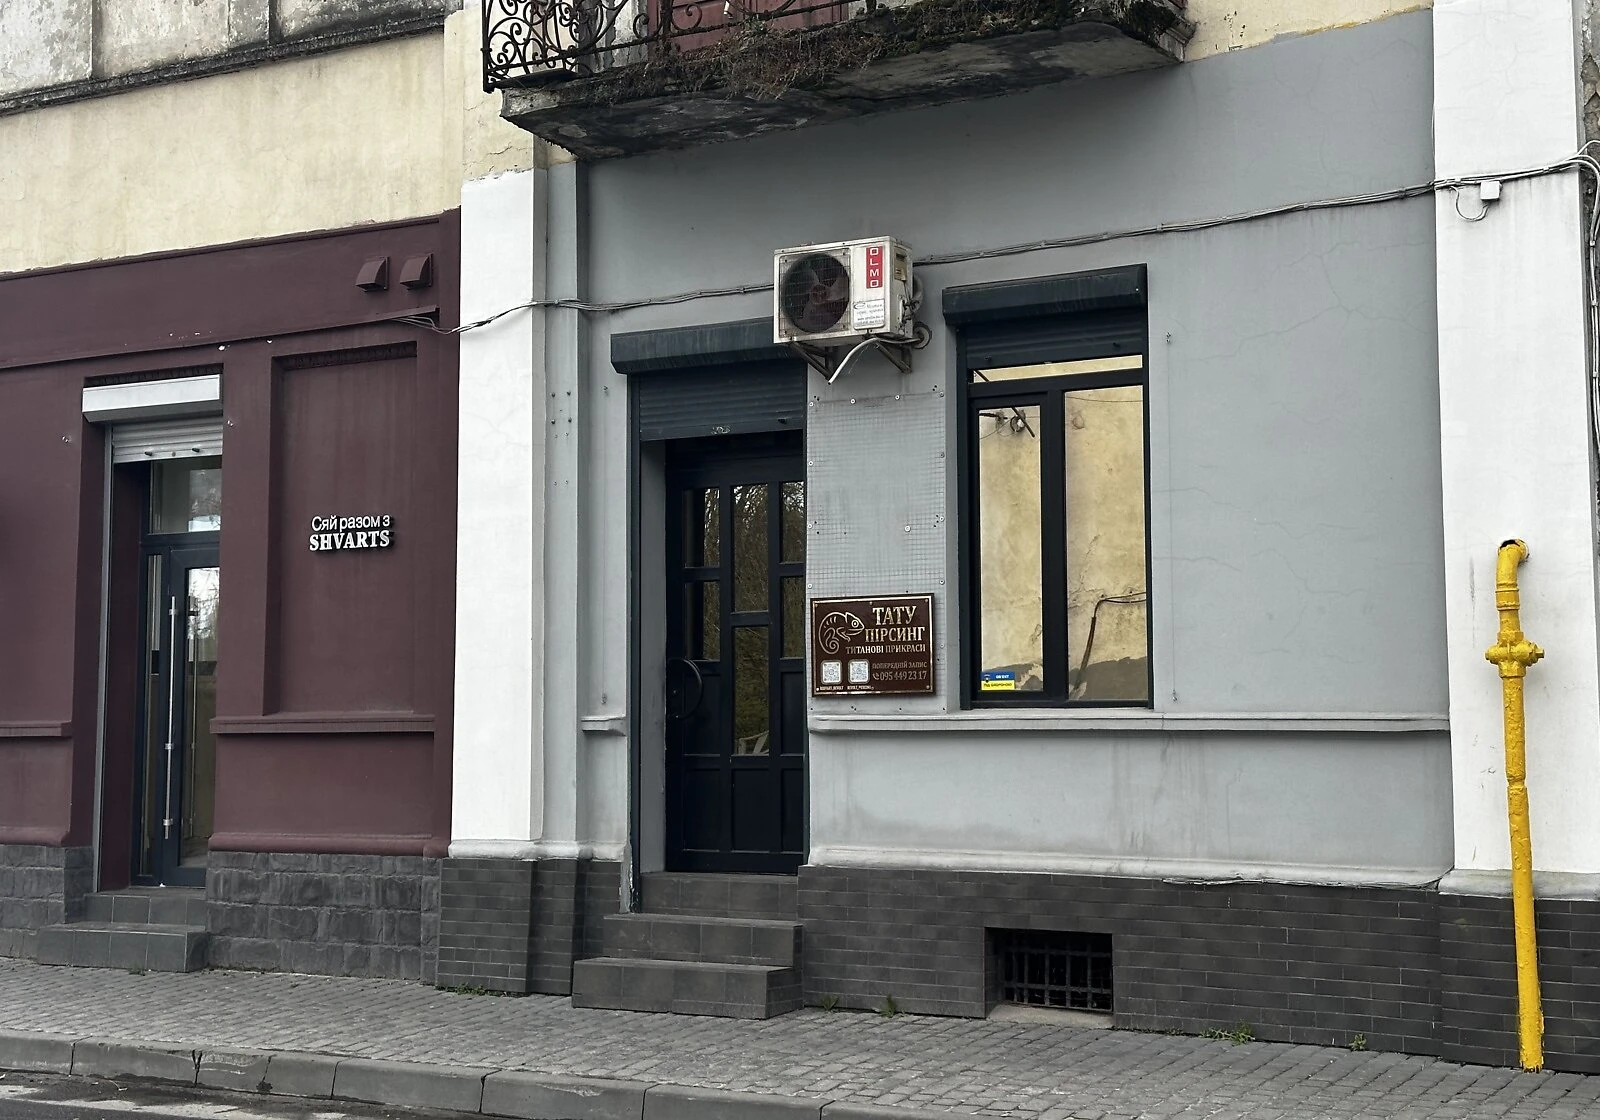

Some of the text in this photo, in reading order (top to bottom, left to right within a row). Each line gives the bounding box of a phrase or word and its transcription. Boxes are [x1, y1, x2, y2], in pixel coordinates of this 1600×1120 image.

[869, 247, 879, 287] OLMO
[312, 515, 390, 532] Сяй разом з
[309, 530, 390, 551] SHVARTS
[873, 605, 917, 625] ТАТУ
[864, 627, 925, 642] ПІРСИНГ
[846, 644, 926, 654] ТИТАНОВІ ПРИКРАСИ
[880, 671, 927, 680] 095 449 23 17
